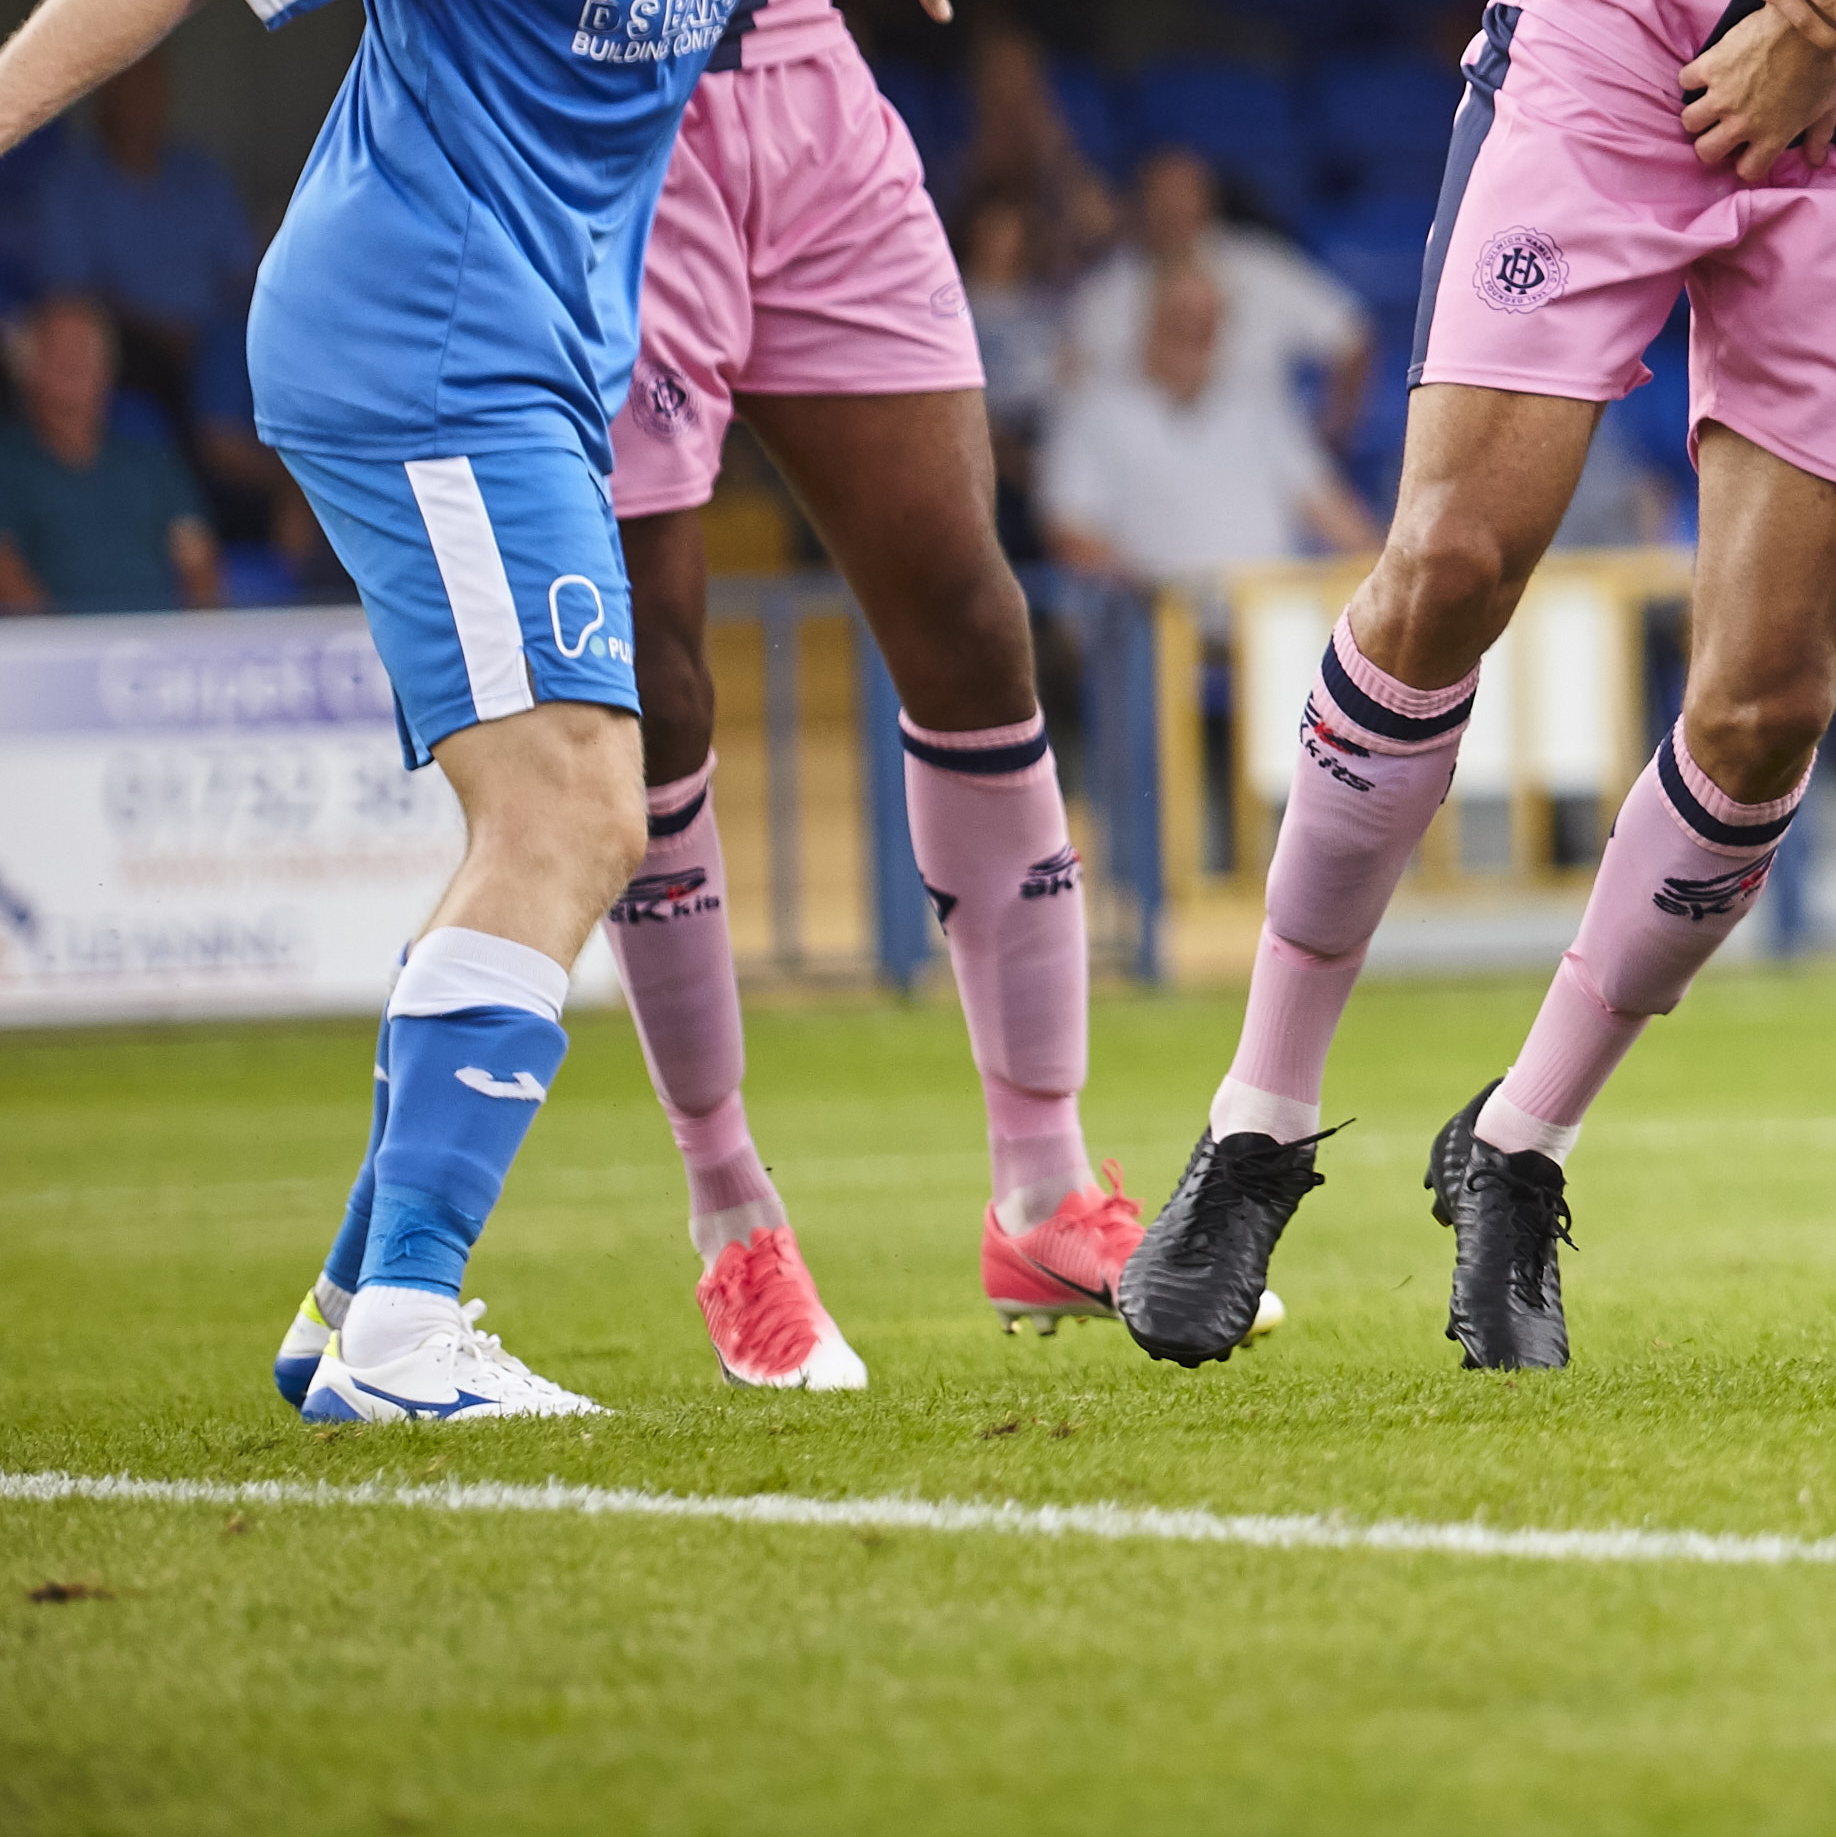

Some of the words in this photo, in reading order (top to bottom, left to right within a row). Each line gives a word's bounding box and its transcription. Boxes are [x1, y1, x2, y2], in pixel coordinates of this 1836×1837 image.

[571, 30, 671, 64] BUILDING
[1484, 236, 1522, 267] DULWICH
[1524, 236, 1556, 267] HAMLET
